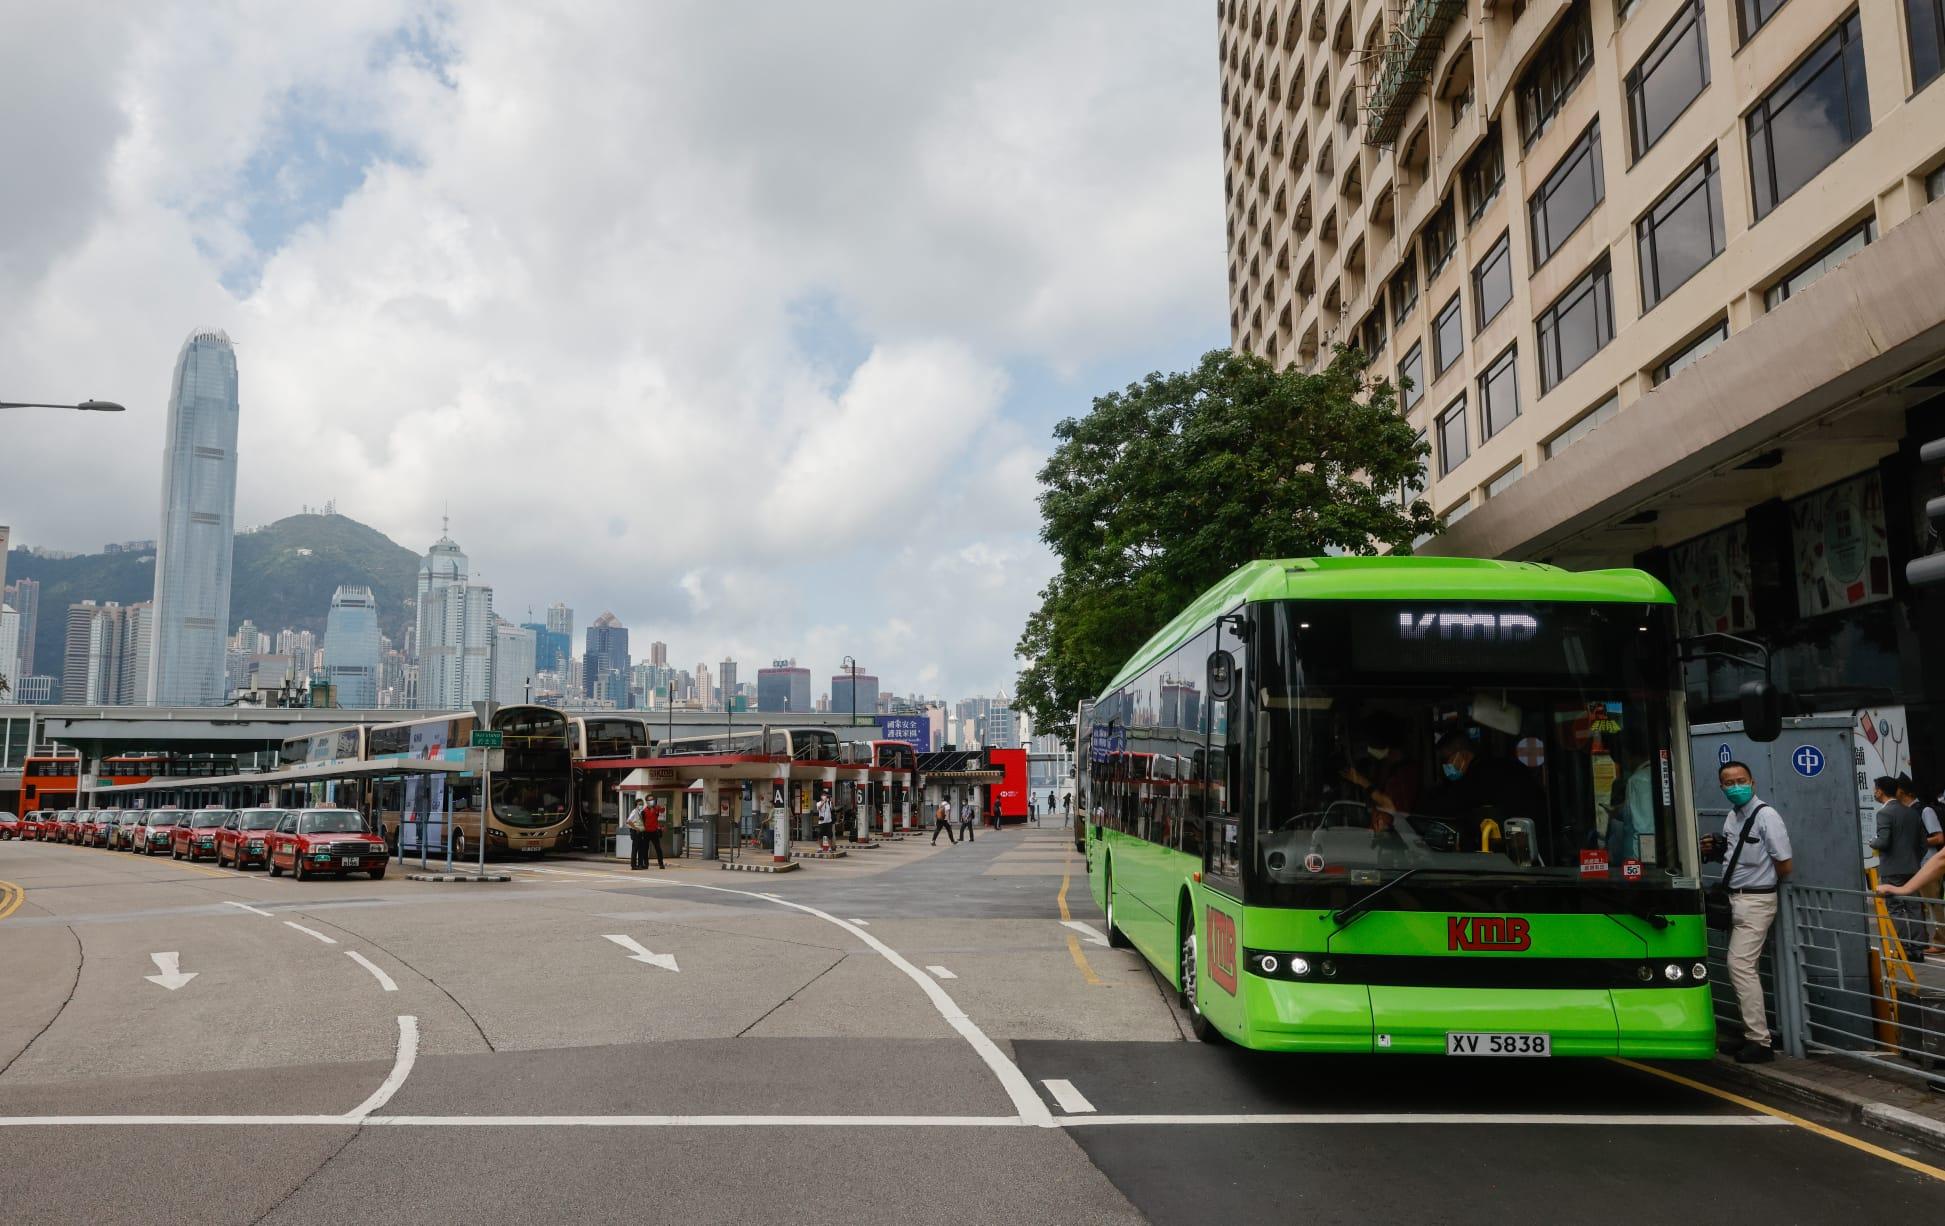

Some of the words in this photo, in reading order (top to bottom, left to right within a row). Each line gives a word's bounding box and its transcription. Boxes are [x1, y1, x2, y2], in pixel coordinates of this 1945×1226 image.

[774, 789, 784, 804] A
[857, 789, 863, 804] 6
[902, 790, 907, 802] 7
[1447, 916, 1532, 951] KMB
[1452, 1036, 1479, 1053] XV
[1490, 1036, 1545, 1053] 5838
